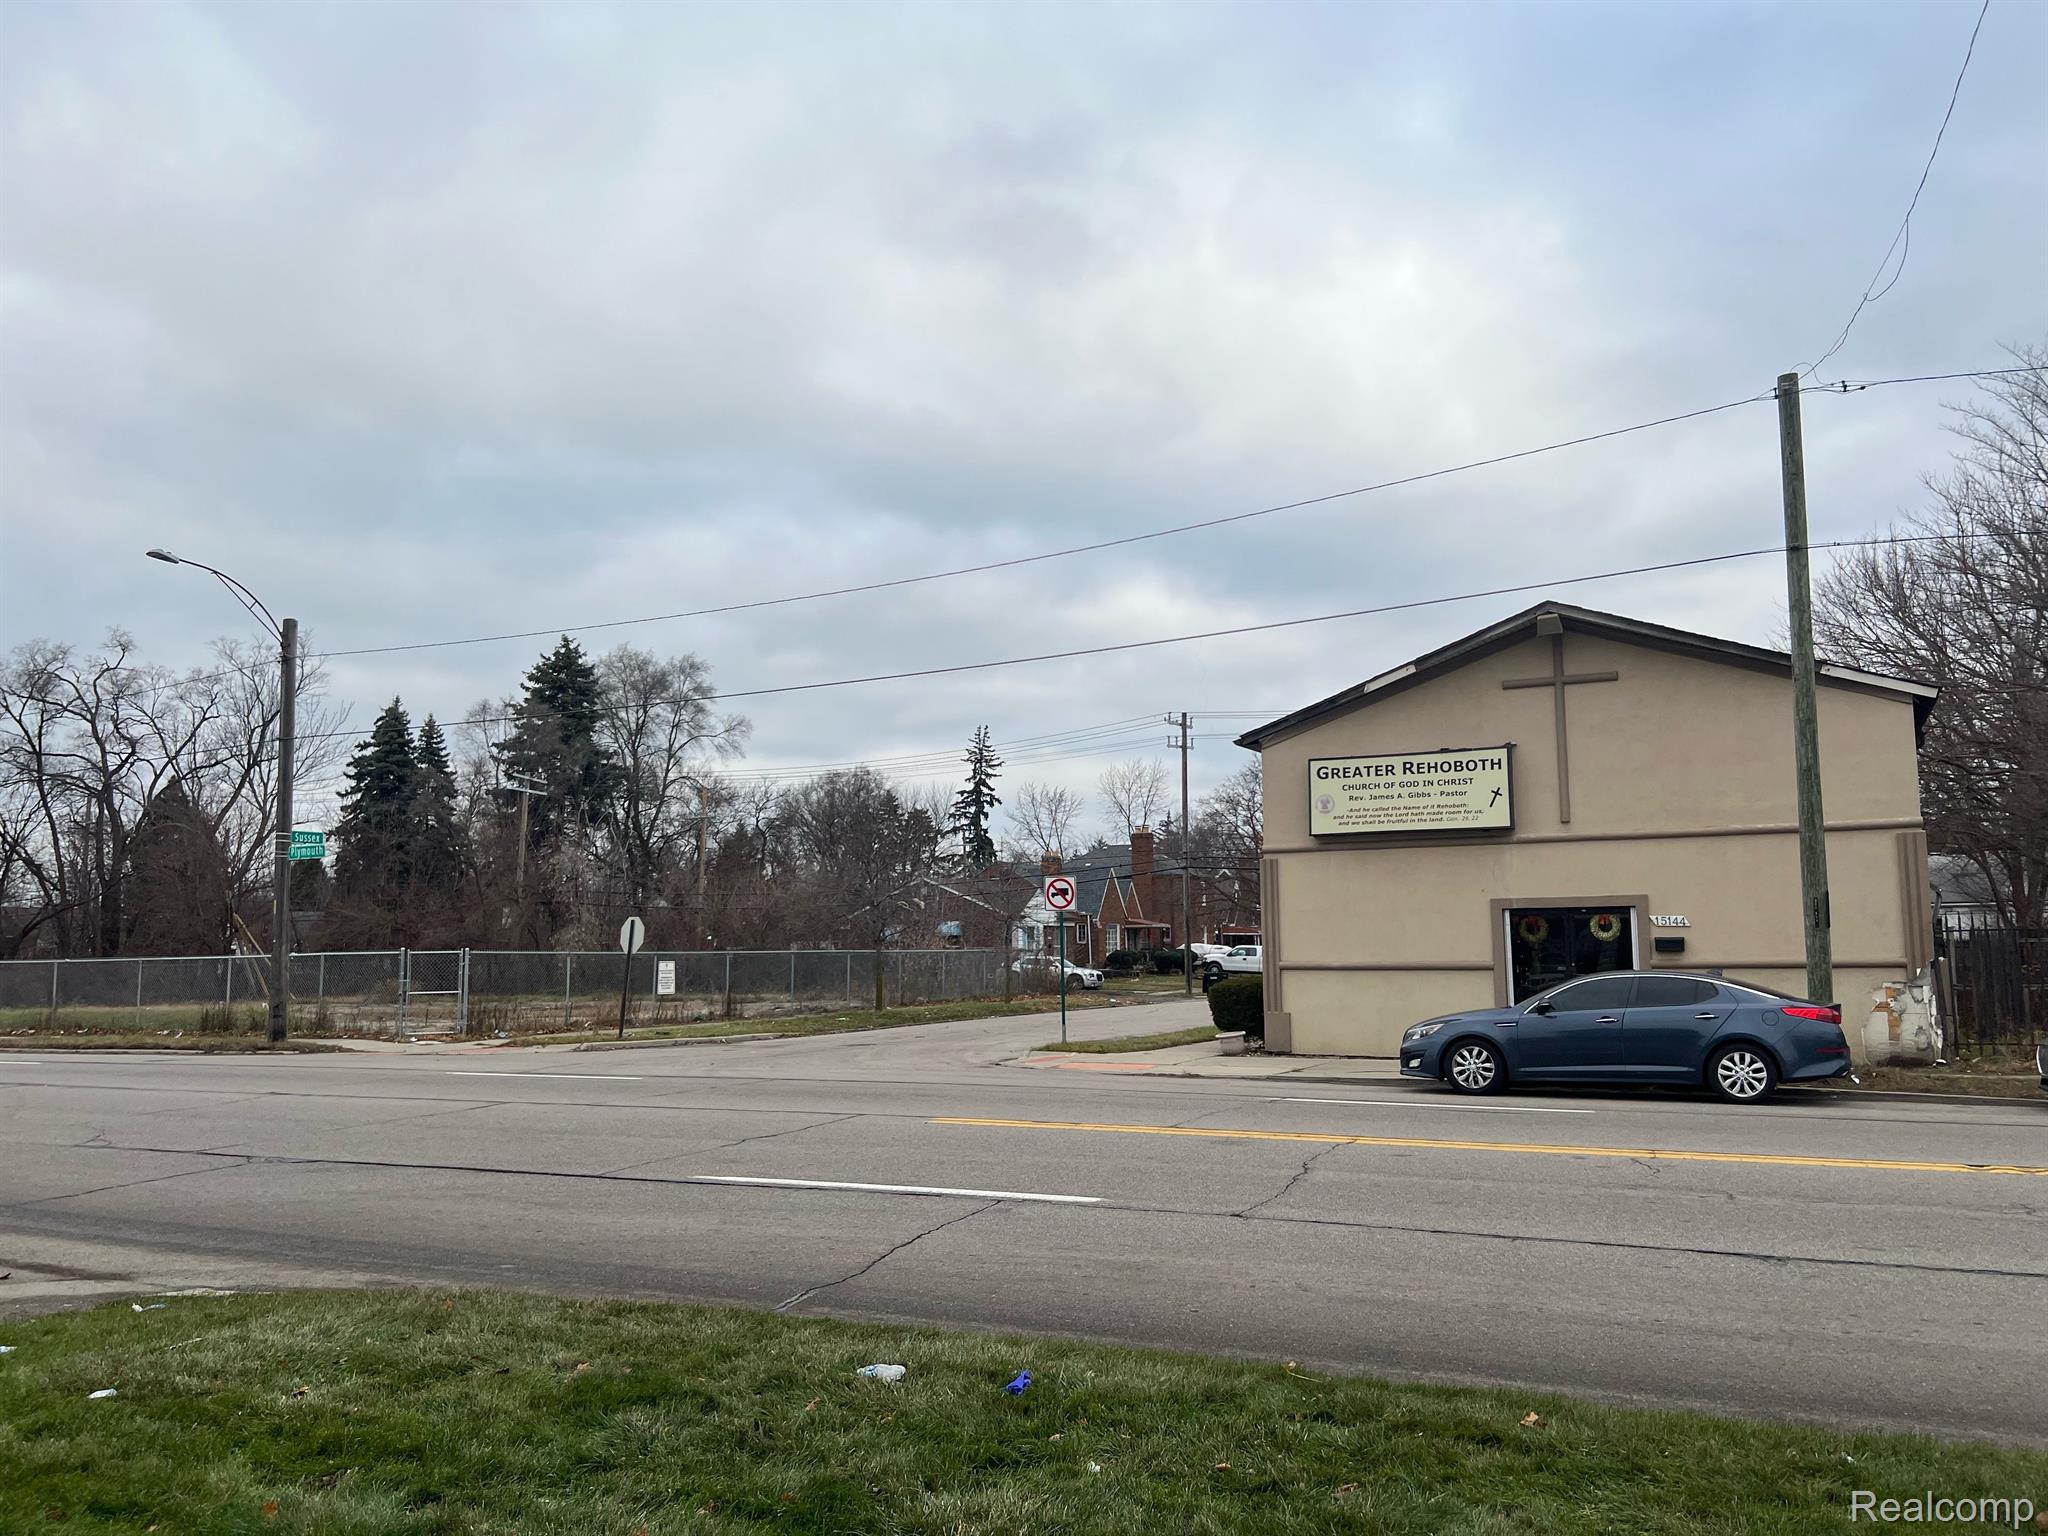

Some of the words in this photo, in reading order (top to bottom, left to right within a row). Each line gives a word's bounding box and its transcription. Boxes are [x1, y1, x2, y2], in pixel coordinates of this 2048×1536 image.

[1316, 764, 1396, 780] GREATER
[1402, 758, 1502, 775] REHOBOTH
[1342, 782, 1381, 792] CHURCH
[1383, 781, 1396, 790] OF
[1398, 780, 1419, 789] GOD
[1422, 779, 1434, 788] IN
[1437, 777, 1474, 787] CHRIST
[1368, 793, 1395, 801] James
[1408, 791, 1431, 799] Gibbs
[294, 832, 320, 842] Sussex
[290, 846, 324, 859] Plymouth
[1655, 916, 1686, 926] 15144
